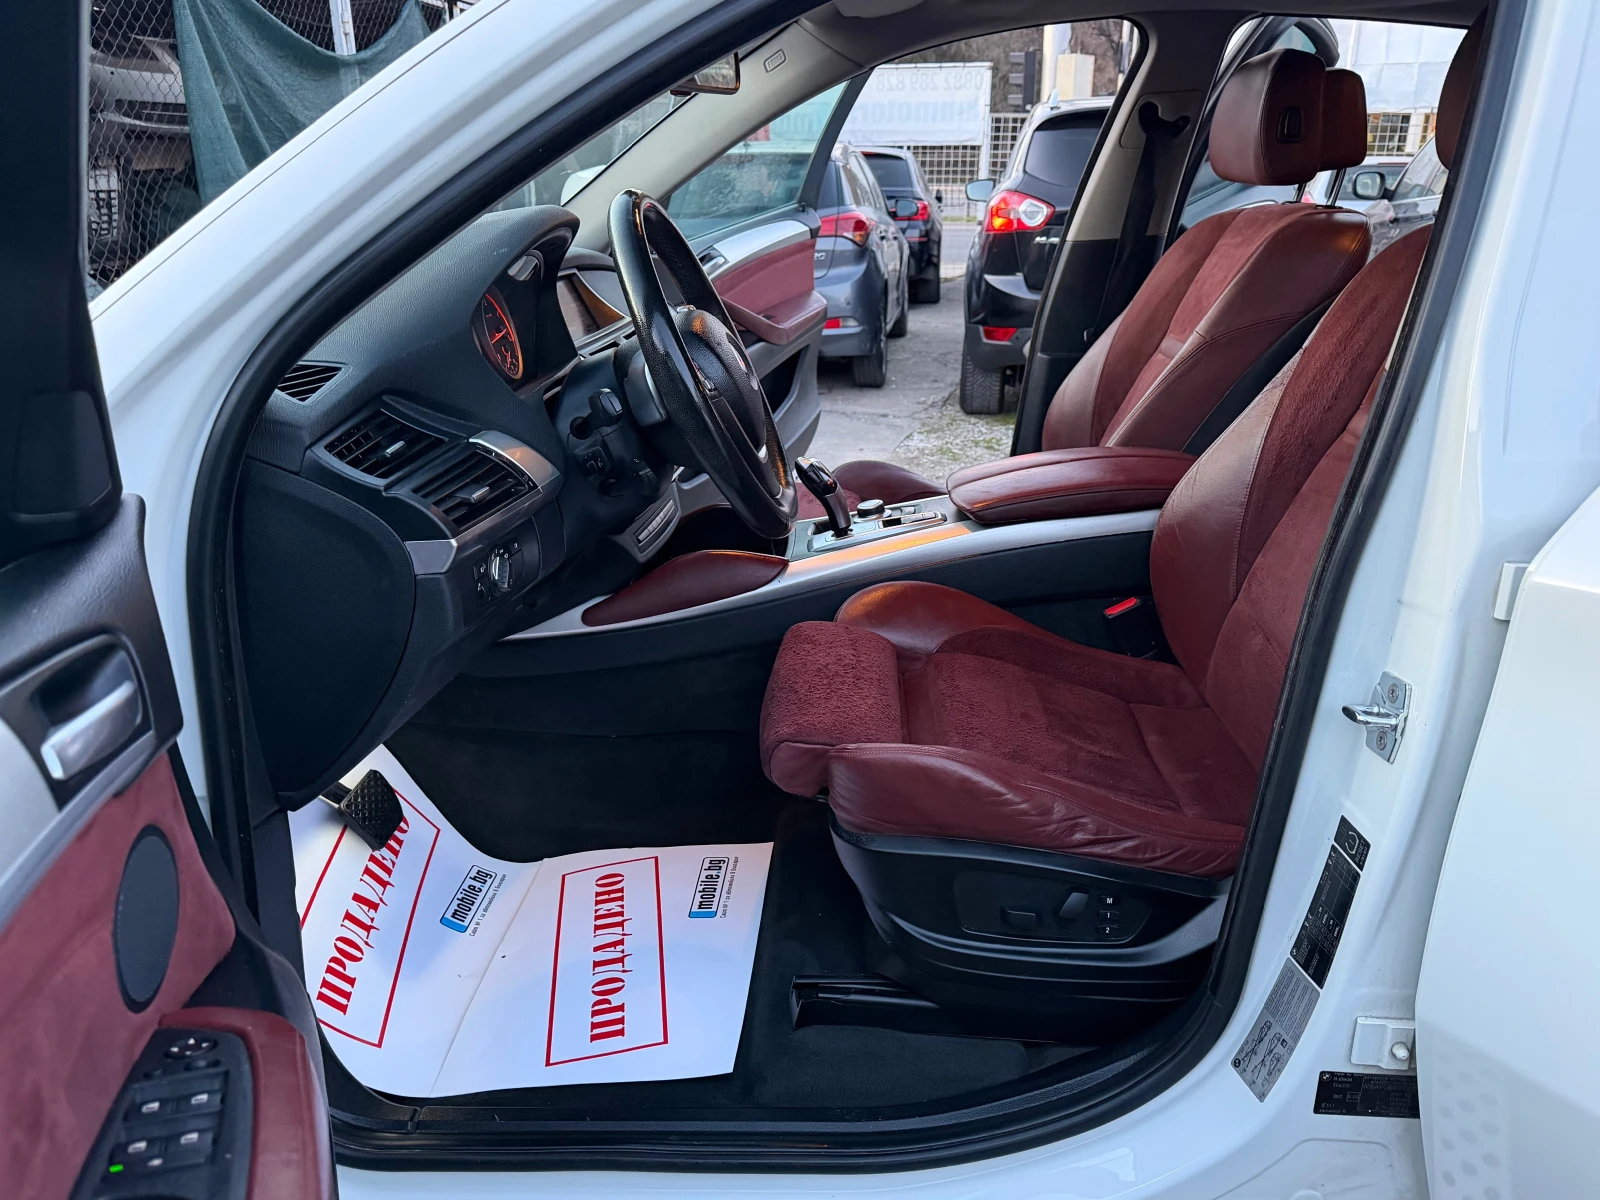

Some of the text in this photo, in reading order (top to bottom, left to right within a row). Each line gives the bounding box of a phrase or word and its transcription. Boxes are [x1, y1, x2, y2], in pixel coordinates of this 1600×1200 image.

[450, 869, 493, 923] mobile.bg
[697, 859, 726, 910] mobile.bg
[590, 872, 632, 1043] ПРОДАДЕНО
